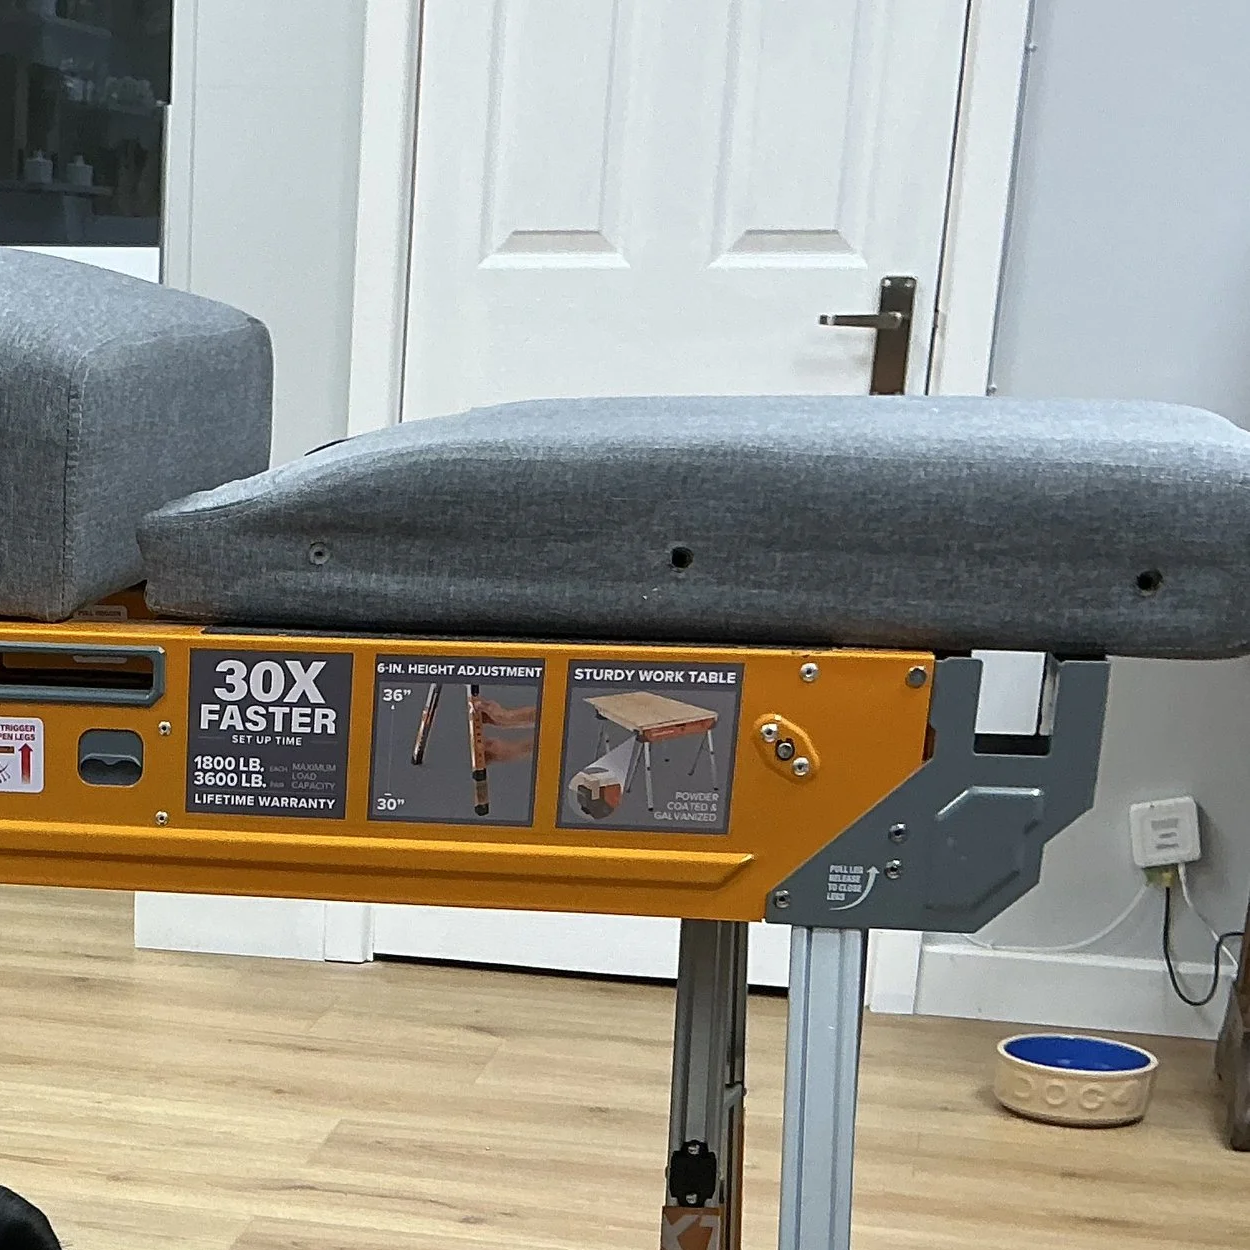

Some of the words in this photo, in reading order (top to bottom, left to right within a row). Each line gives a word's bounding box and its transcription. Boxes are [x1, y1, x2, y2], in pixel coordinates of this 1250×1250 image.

[376, 662, 406, 675] 6-IN.
[408, 664, 455, 676] HEIGHT
[457, 665, 543, 678] ADJUSTMENT
[574, 667, 636, 682] STURDY
[639, 670, 685, 683] WORK
[688, 671, 737, 684] TABLE
[213, 659, 327, 704] 30X
[200, 703, 337, 734] FASTER
[0, 724, 35, 733] TRIGGER
[14, 733, 35, 742] LEGS
[231, 734, 252, 744] SET
[256, 735, 272, 745] UP
[275, 736, 302, 746] TIME
[193, 755, 236, 771] 1800
[239, 756, 265, 772] LB.
[193, 771, 238, 786] 3600
[241, 773, 267, 788] LB.
[291, 771, 317, 781] LOAD
[291, 781, 336, 790] CAPACITY
[194, 793, 255, 806] LIFETIME
[258, 796, 336, 809] WARRANTY
[675, 791, 720, 801] POWDER
[666, 801, 708, 812] COATED
[653, 811, 717, 822] GALVANIZED
